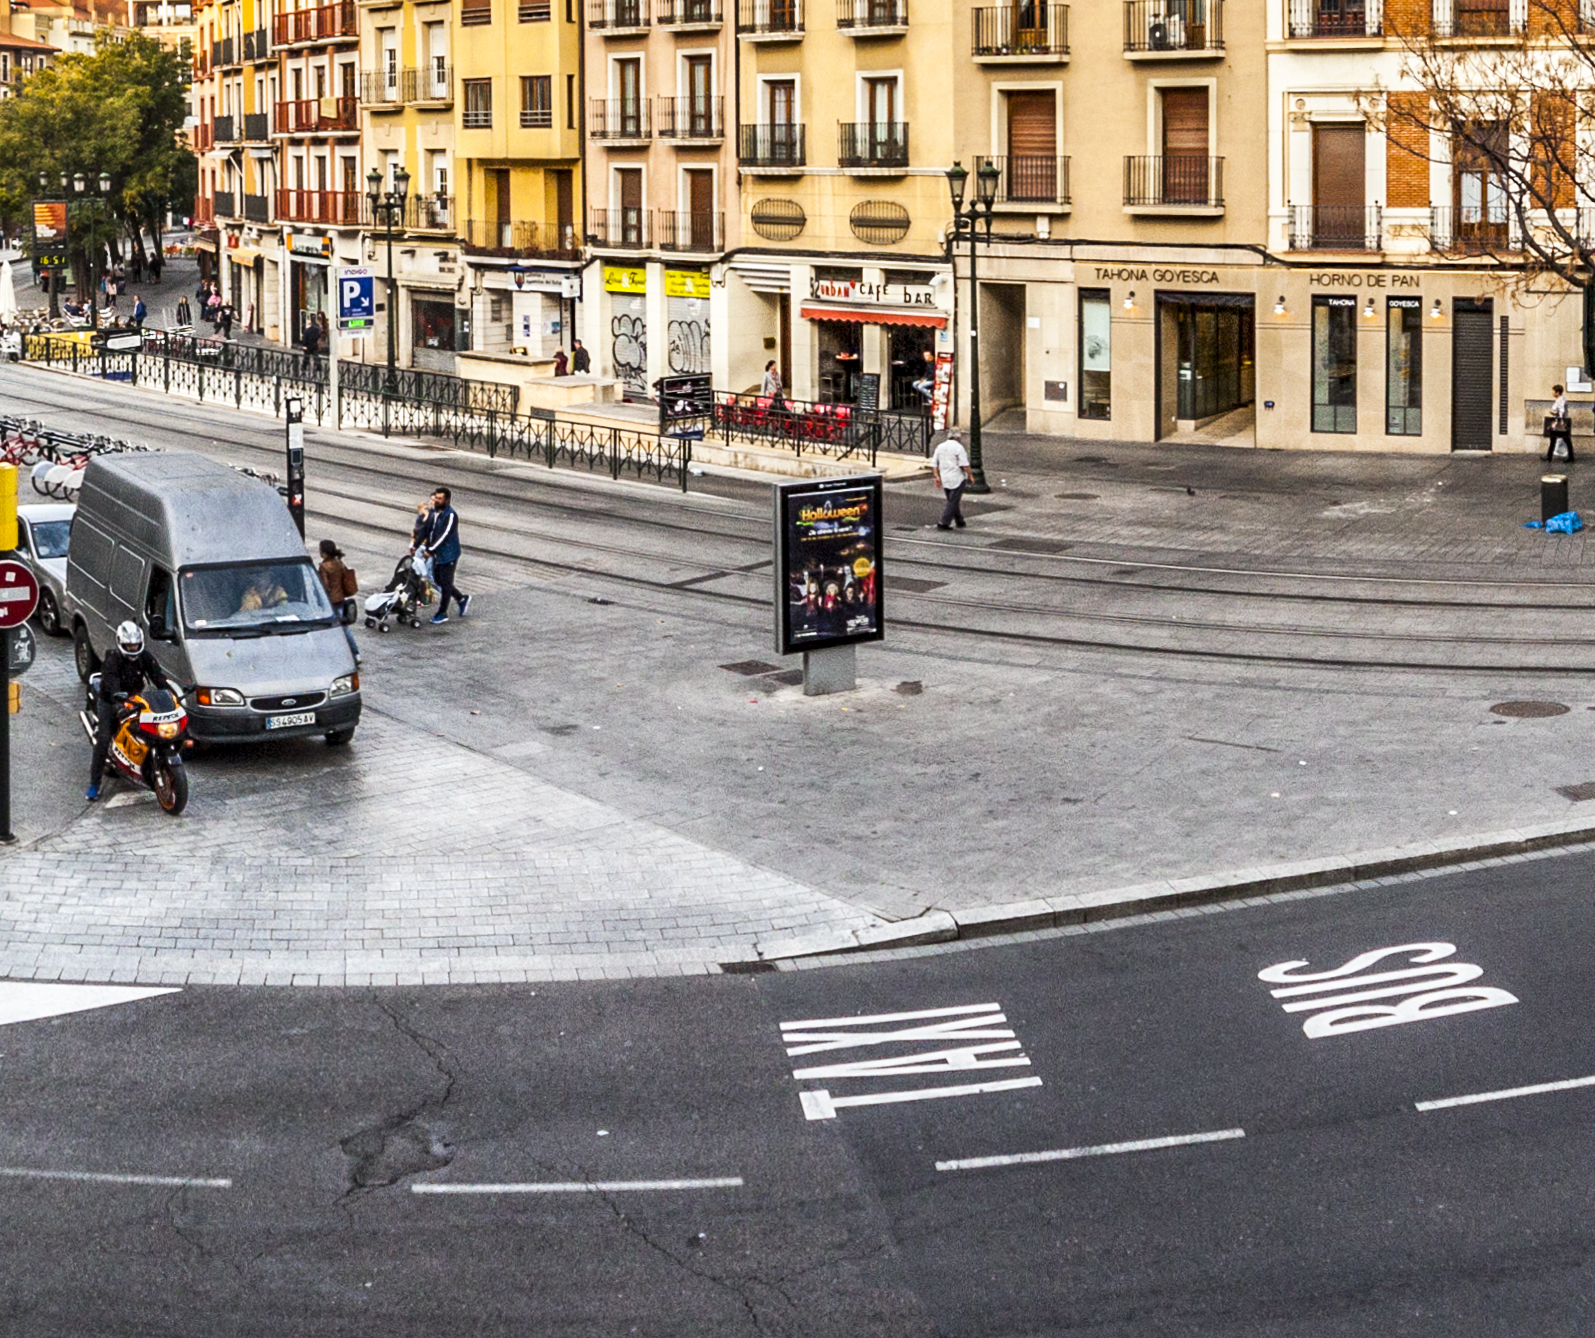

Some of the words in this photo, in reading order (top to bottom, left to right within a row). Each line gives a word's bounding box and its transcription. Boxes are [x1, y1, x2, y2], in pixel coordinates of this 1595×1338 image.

[1095, 268, 1147, 282] TAHONA
[1153, 269, 1219, 284] GOYESCA
[1310, 273, 1362, 287] HORNO
[1367, 275, 1387, 287] DE
[1392, 275, 1420, 288] PAN
[343, 281, 361, 308] P
[1258, 942, 1520, 1039] BUS
[779, 1002, 1043, 1120] TAXI
